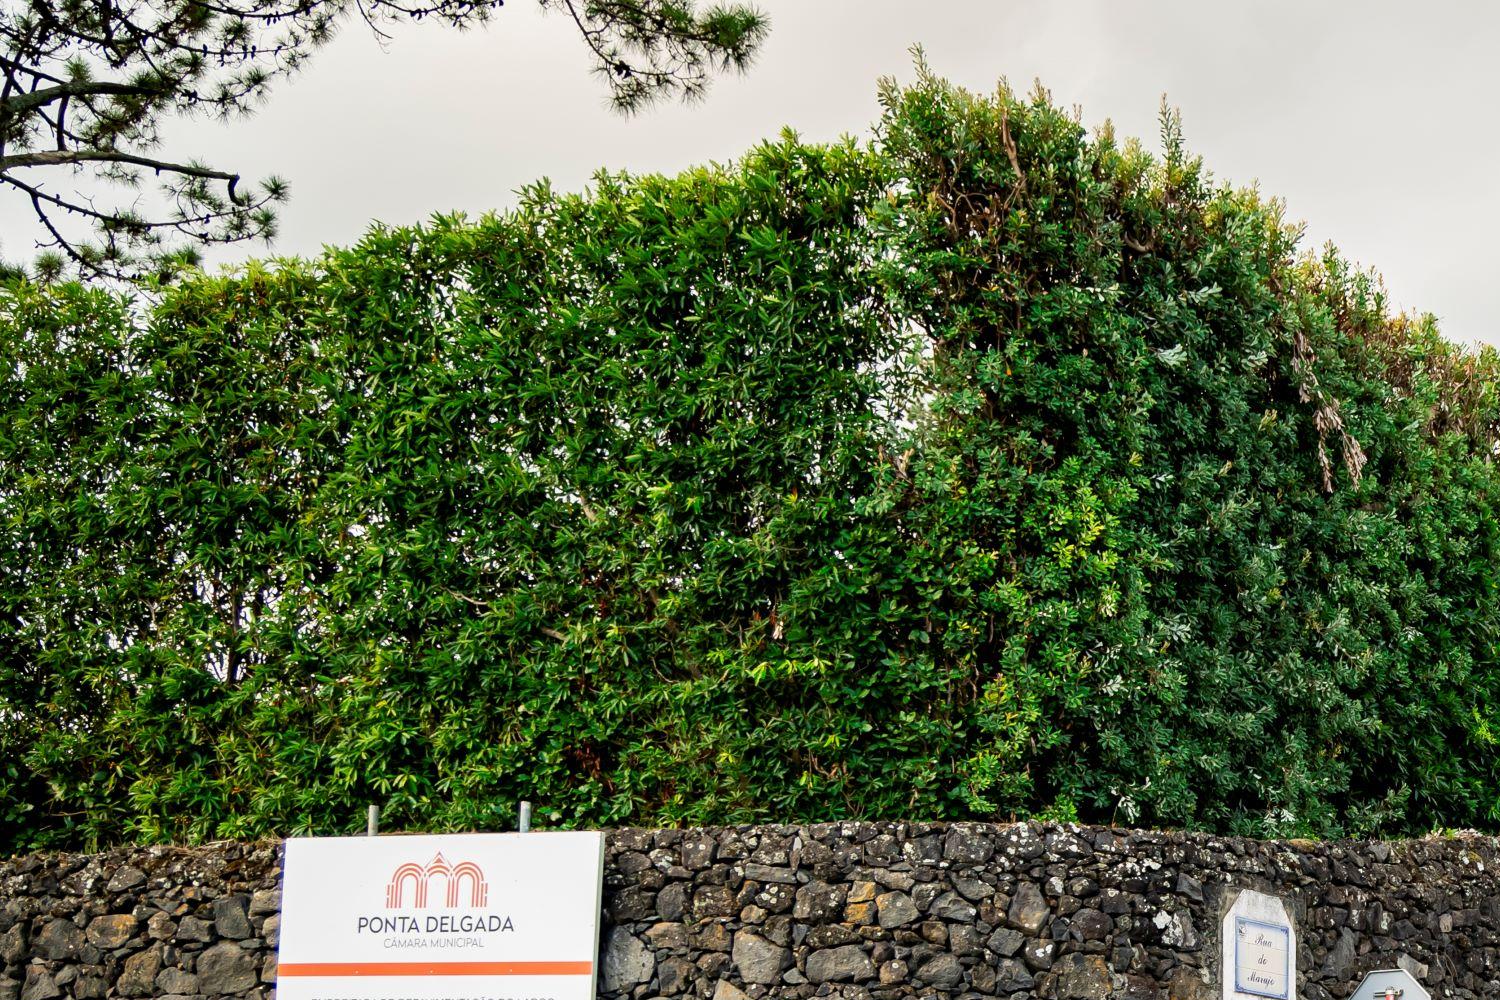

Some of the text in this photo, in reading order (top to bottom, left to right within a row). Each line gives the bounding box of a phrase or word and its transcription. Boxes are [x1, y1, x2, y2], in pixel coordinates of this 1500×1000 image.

[358, 915, 515, 933] PONTA DELGADA
[383, 937, 485, 949] CÂMARA MUNICIPAL
[1255, 934, 1272, 947] Rua
[1248, 972, 1274, 989] Marujo
